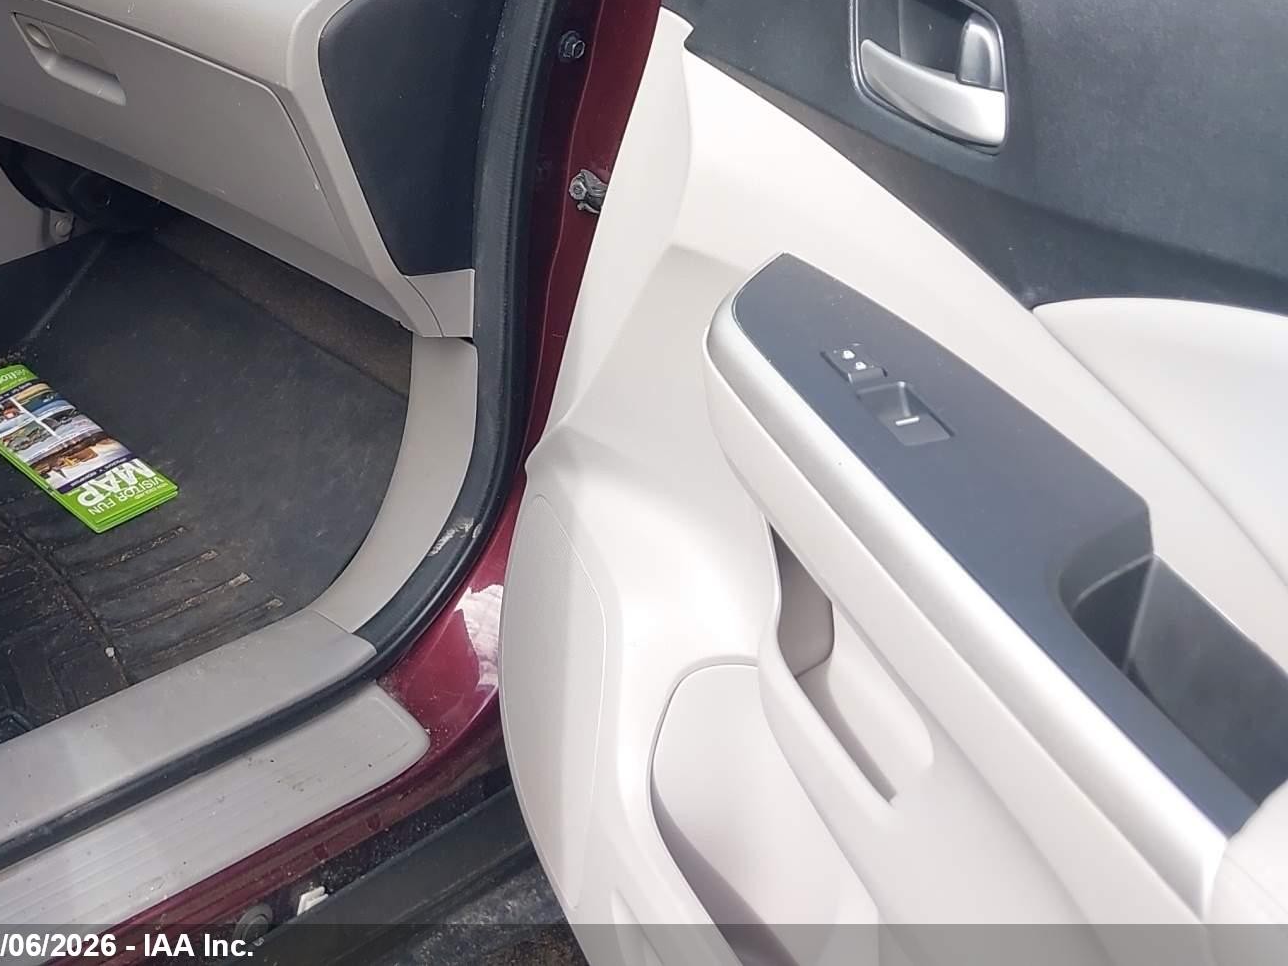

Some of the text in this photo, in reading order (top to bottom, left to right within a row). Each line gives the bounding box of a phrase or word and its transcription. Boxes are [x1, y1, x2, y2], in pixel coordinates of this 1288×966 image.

[77, 458, 157, 507] MAP
[87, 476, 164, 515] VISITOR FUN
